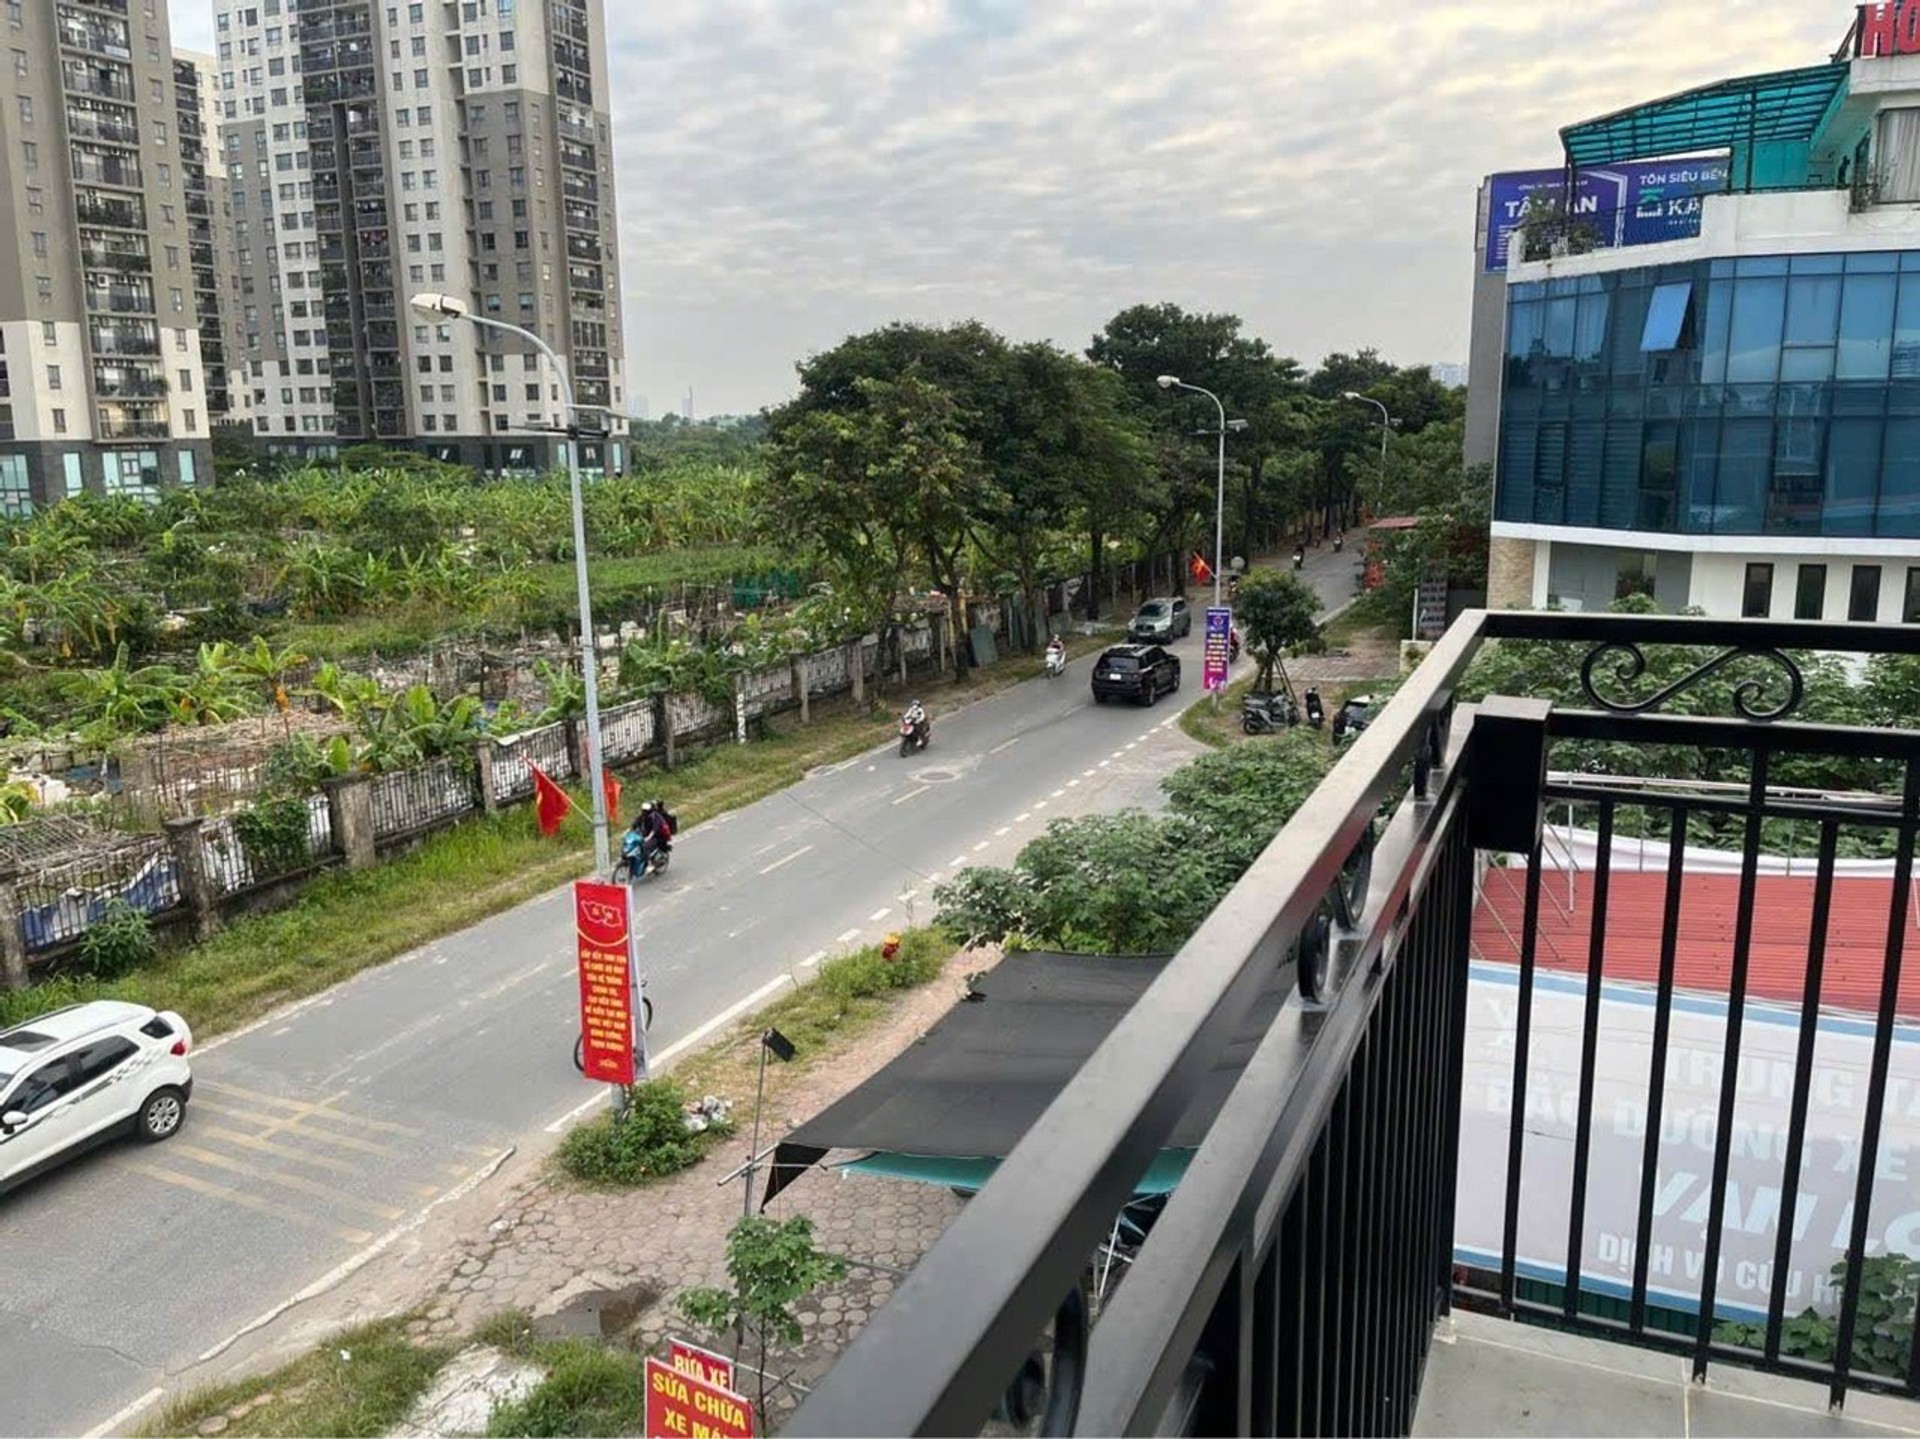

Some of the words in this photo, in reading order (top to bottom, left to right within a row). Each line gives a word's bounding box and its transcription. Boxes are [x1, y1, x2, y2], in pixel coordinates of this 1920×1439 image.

[1640, 173, 1666, 185] TÔN
[1669, 170, 1698, 183] SIÊU
[708, 1366, 728, 1388] XE
[653, 1372, 689, 1405] SỬA
[694, 1391, 746, 1430] CHỮA
[664, 1406, 688, 1436] XE
